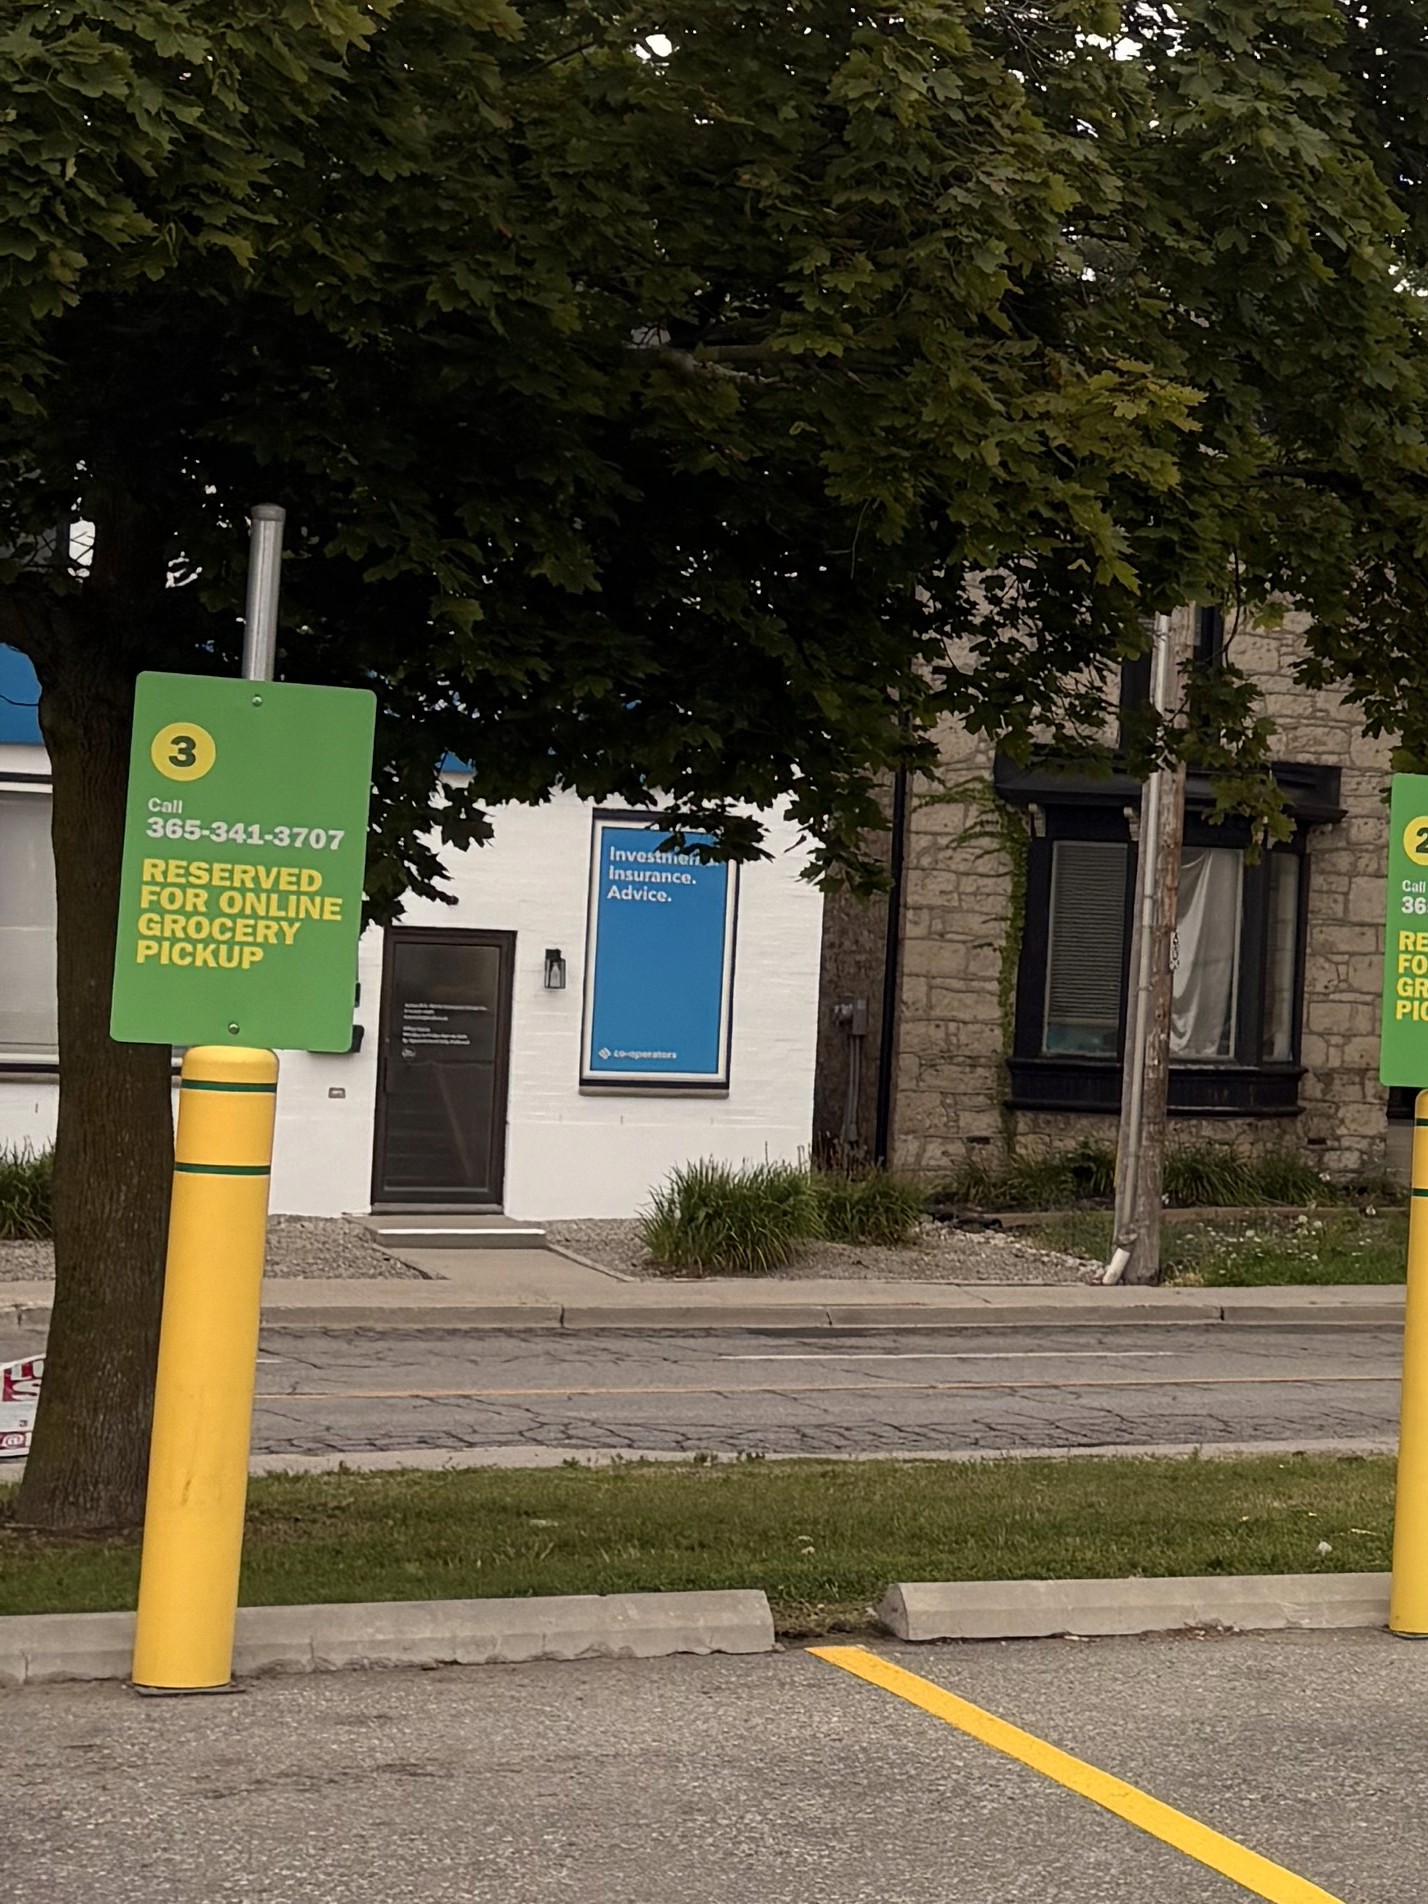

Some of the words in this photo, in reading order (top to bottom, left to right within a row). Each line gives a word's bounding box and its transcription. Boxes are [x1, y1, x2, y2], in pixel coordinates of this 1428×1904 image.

[168, 735, 196, 767] 3
[148, 797, 182, 813] Call
[146, 816, 345, 850] 365-341-3707
[142, 858, 322, 892] RESERVED
[608, 865, 697, 885] Insurance.
[1402, 880, 1426, 893] Call
[140, 885, 208, 912] FOR
[219, 891, 343, 921] ONLINE
[607, 885, 672, 903] Advice.
[137, 912, 301, 945] GROCERY
[136, 940, 264, 969] PICKUP
